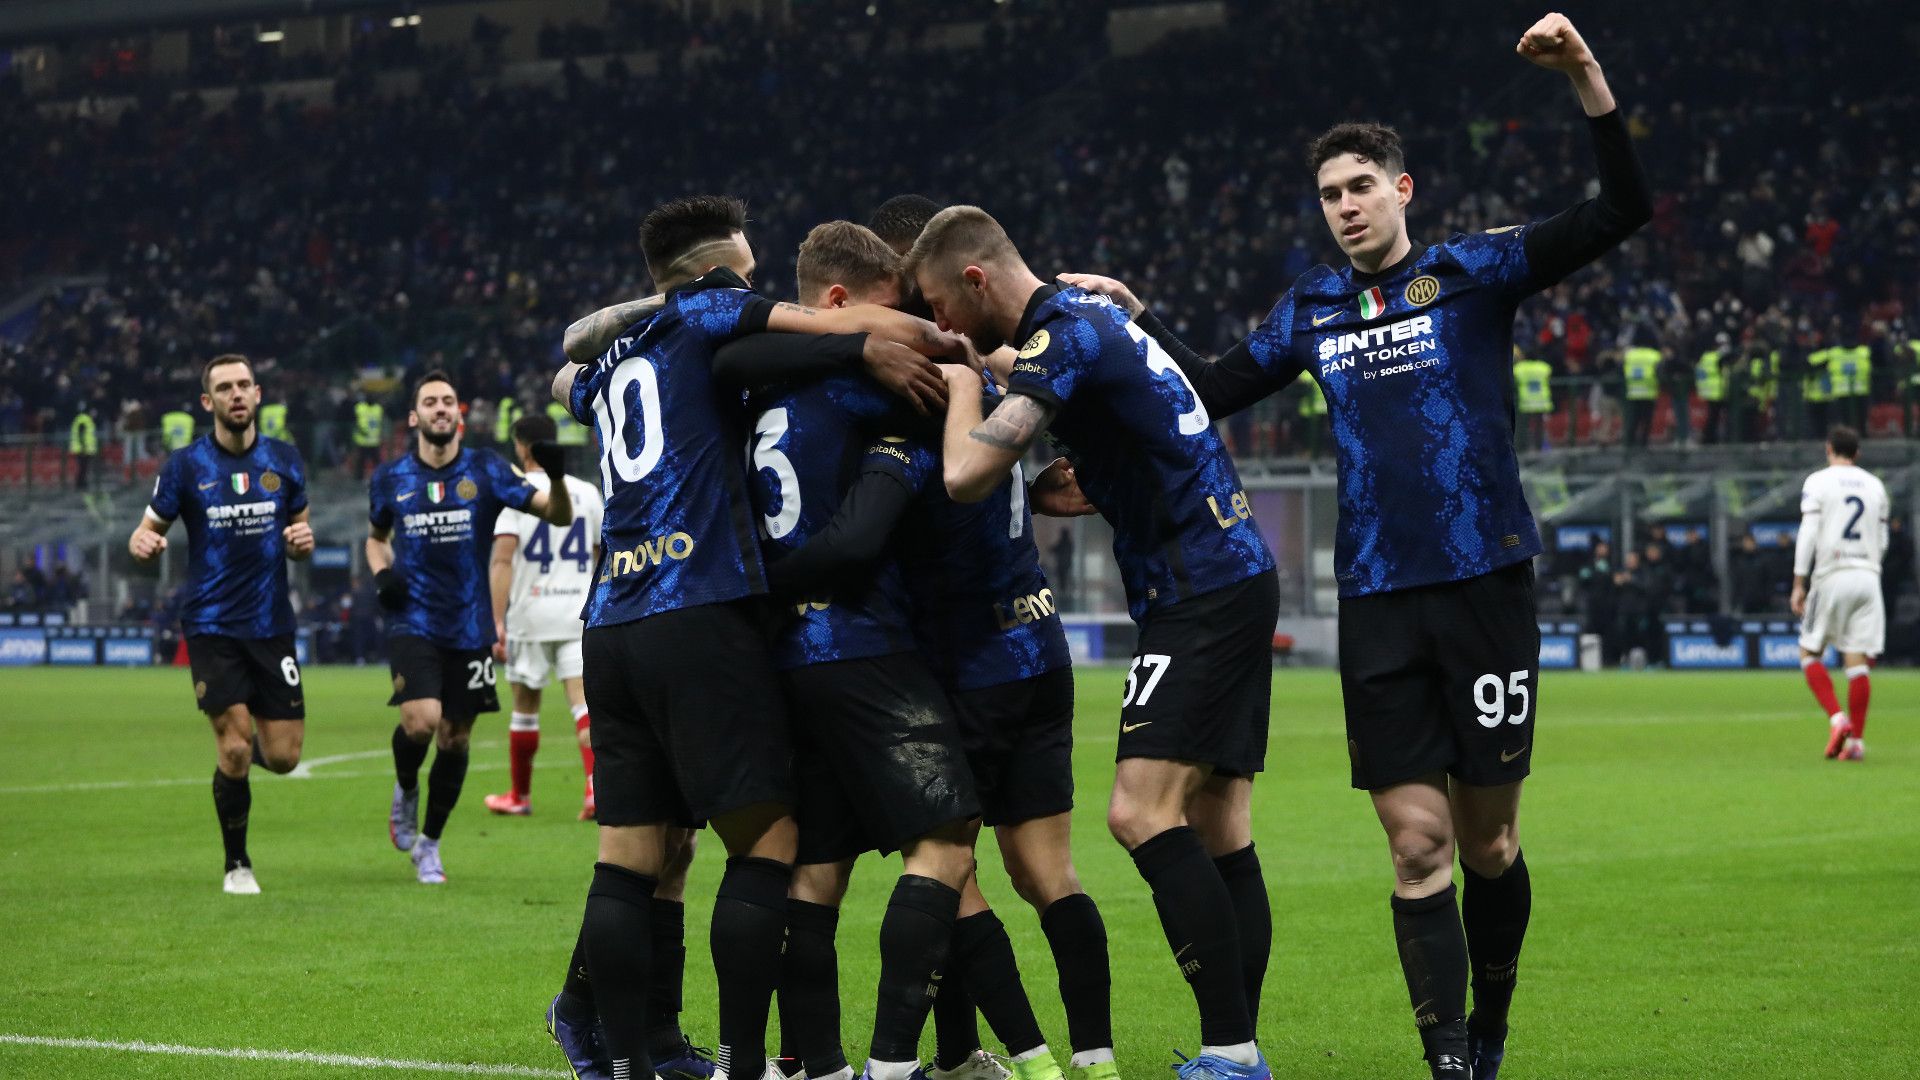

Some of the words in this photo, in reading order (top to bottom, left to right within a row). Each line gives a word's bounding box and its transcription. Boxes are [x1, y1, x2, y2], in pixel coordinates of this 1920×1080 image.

[1321, 355, 1356, 377] FAN
[1363, 338, 1436, 363] TOKEN
[1363, 370, 1377, 380] by
[1380, 357, 1440, 377] socios.com
[591, 356, 664, 501] 10
[745, 407, 802, 540] 3
[868, 445, 912, 465] gitalbits
[1843, 495, 1865, 540] 2
[523, 516, 590, 574] 44
[993, 588, 1057, 630] Leno
[280, 655, 300, 687] 6
[467, 656, 497, 689] 20
[1122, 654, 1171, 708] 37
[1473, 669, 1529, 728] 95
